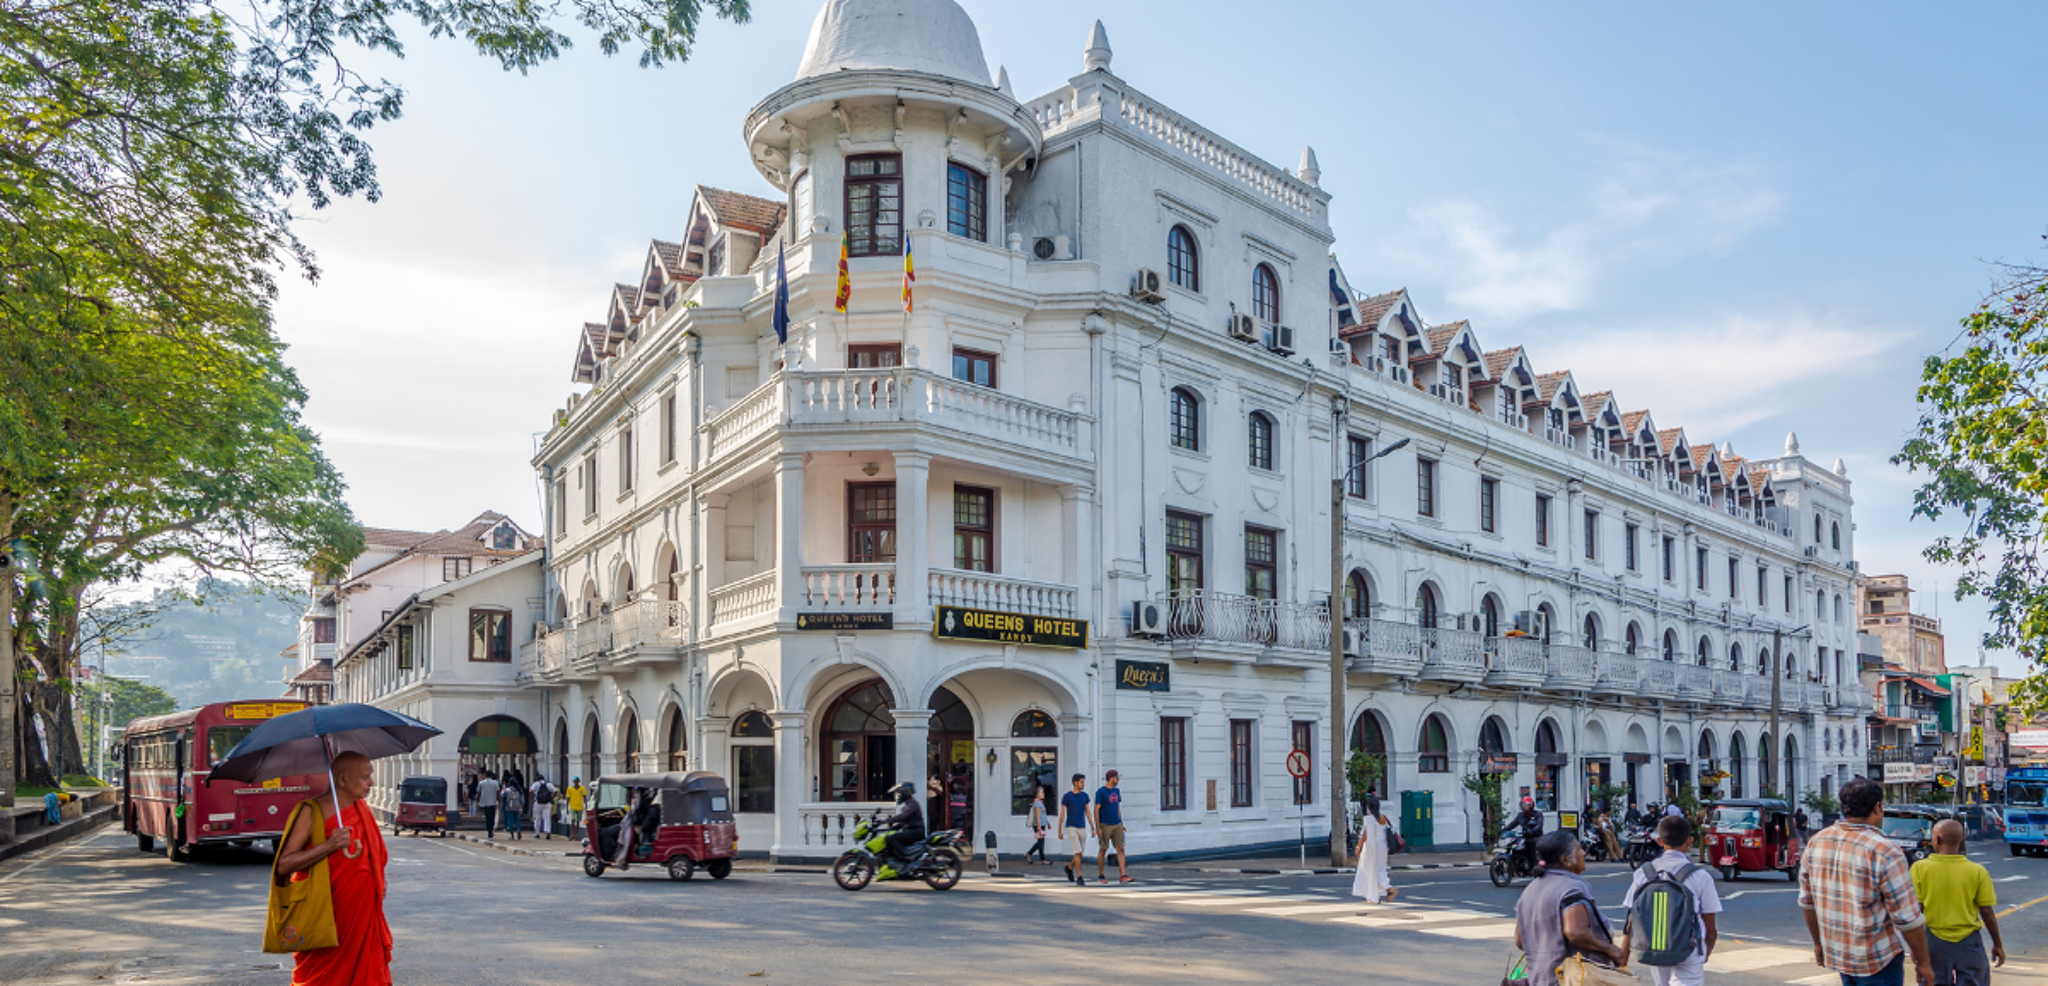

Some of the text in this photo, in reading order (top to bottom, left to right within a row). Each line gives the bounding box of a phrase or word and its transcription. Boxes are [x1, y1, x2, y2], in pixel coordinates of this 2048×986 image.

[809, 614, 849, 622] QUEEN'S
[964, 612, 1079, 637] QUEEN'S HOTEL
[1000, 632, 1033, 642] KANDY
[1973, 727, 1981, 751] TAXI
